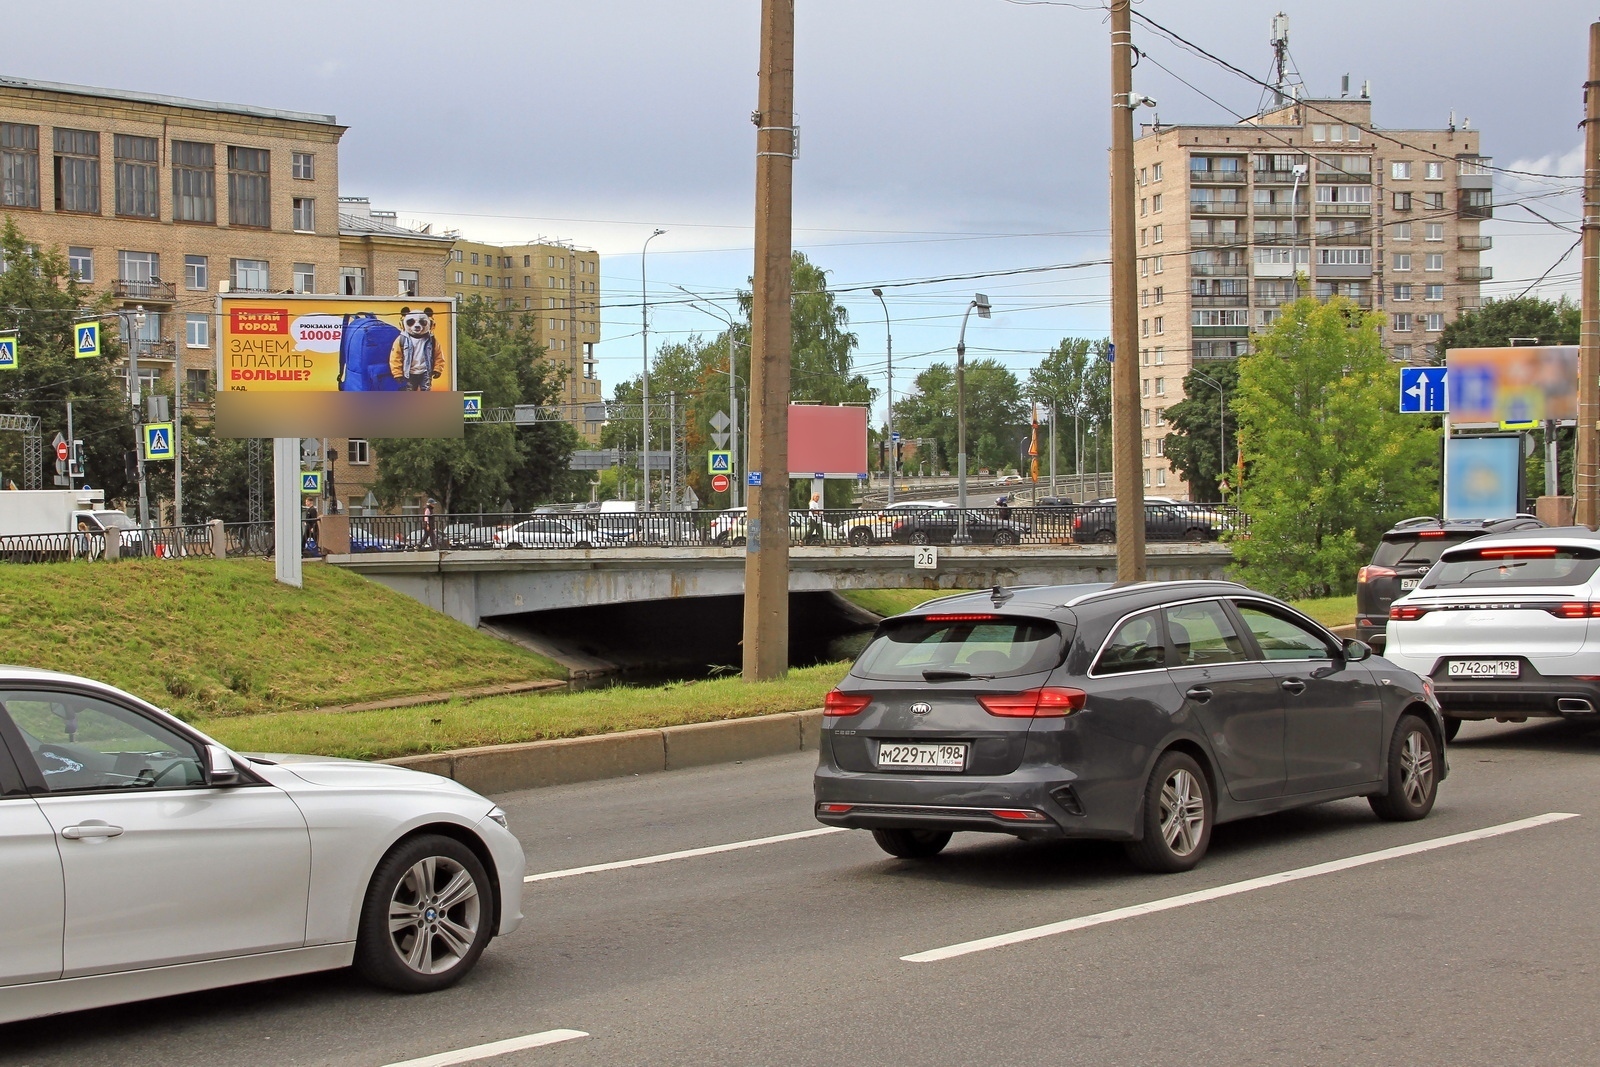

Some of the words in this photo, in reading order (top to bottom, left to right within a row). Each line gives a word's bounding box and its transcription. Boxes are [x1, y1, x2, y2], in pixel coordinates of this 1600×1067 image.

[238, 322, 278, 332] ГОРОД
[231, 339, 290, 353] ЗАЧЕМ
[231, 354, 314, 368] ПЛАТИТЬ
[231, 369, 311, 381] БОЛЬШЕ?
[918, 553, 933, 565] 2.6
[1403, 579, 1420, 588] В77
[912, 703, 927, 712] KIA
[883, 746, 936, 764] М229ТХ
[939, 746, 960, 759] 198
